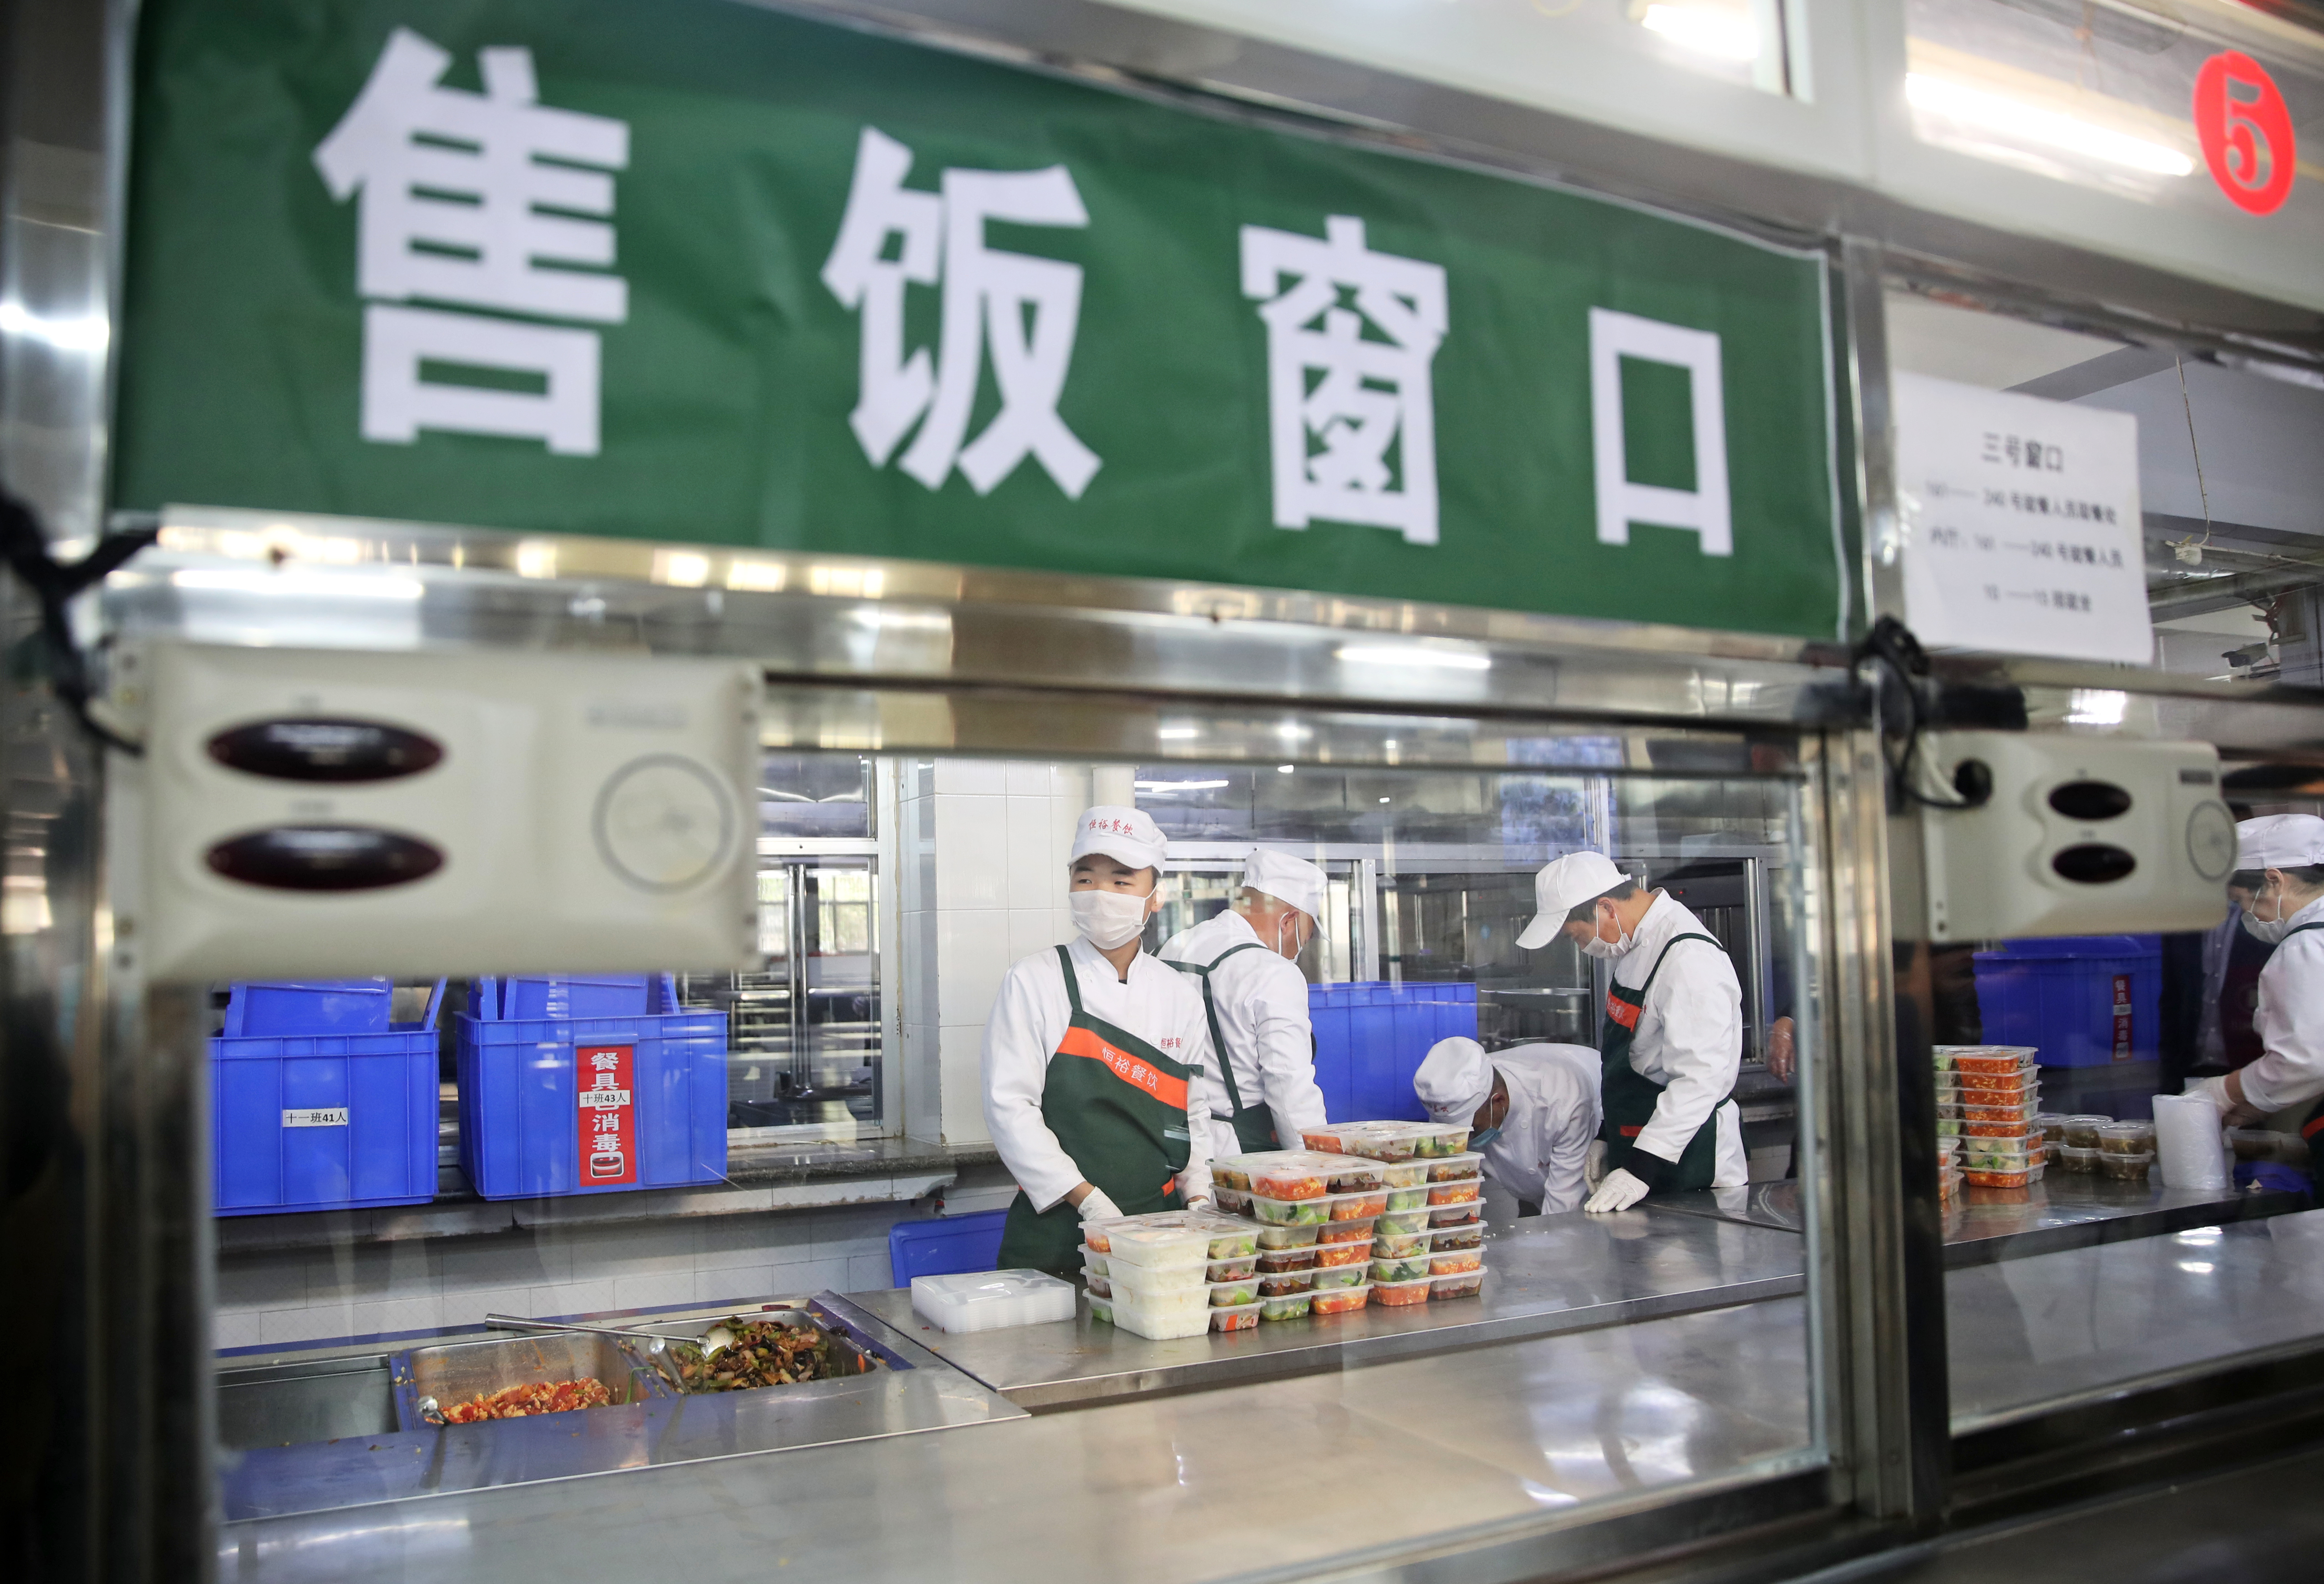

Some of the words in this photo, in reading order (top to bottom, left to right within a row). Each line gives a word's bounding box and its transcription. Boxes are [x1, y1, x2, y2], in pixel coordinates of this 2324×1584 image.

[312, 25, 1733, 555] 售饭窗口
[1981, 432, 2064, 472] 三号窗口
[1088, 818, 1133, 836] 恒裕餐饮
[1161, 1037, 1183, 1049] 恒裕餐
[1102, 1046, 1158, 1091] 恒裕餐饮
[583, 1092, 627, 1104] 十班43人
[591, 1052, 621, 1152] 餐具消毒
[285, 1111, 346, 1124] 十一班41人
